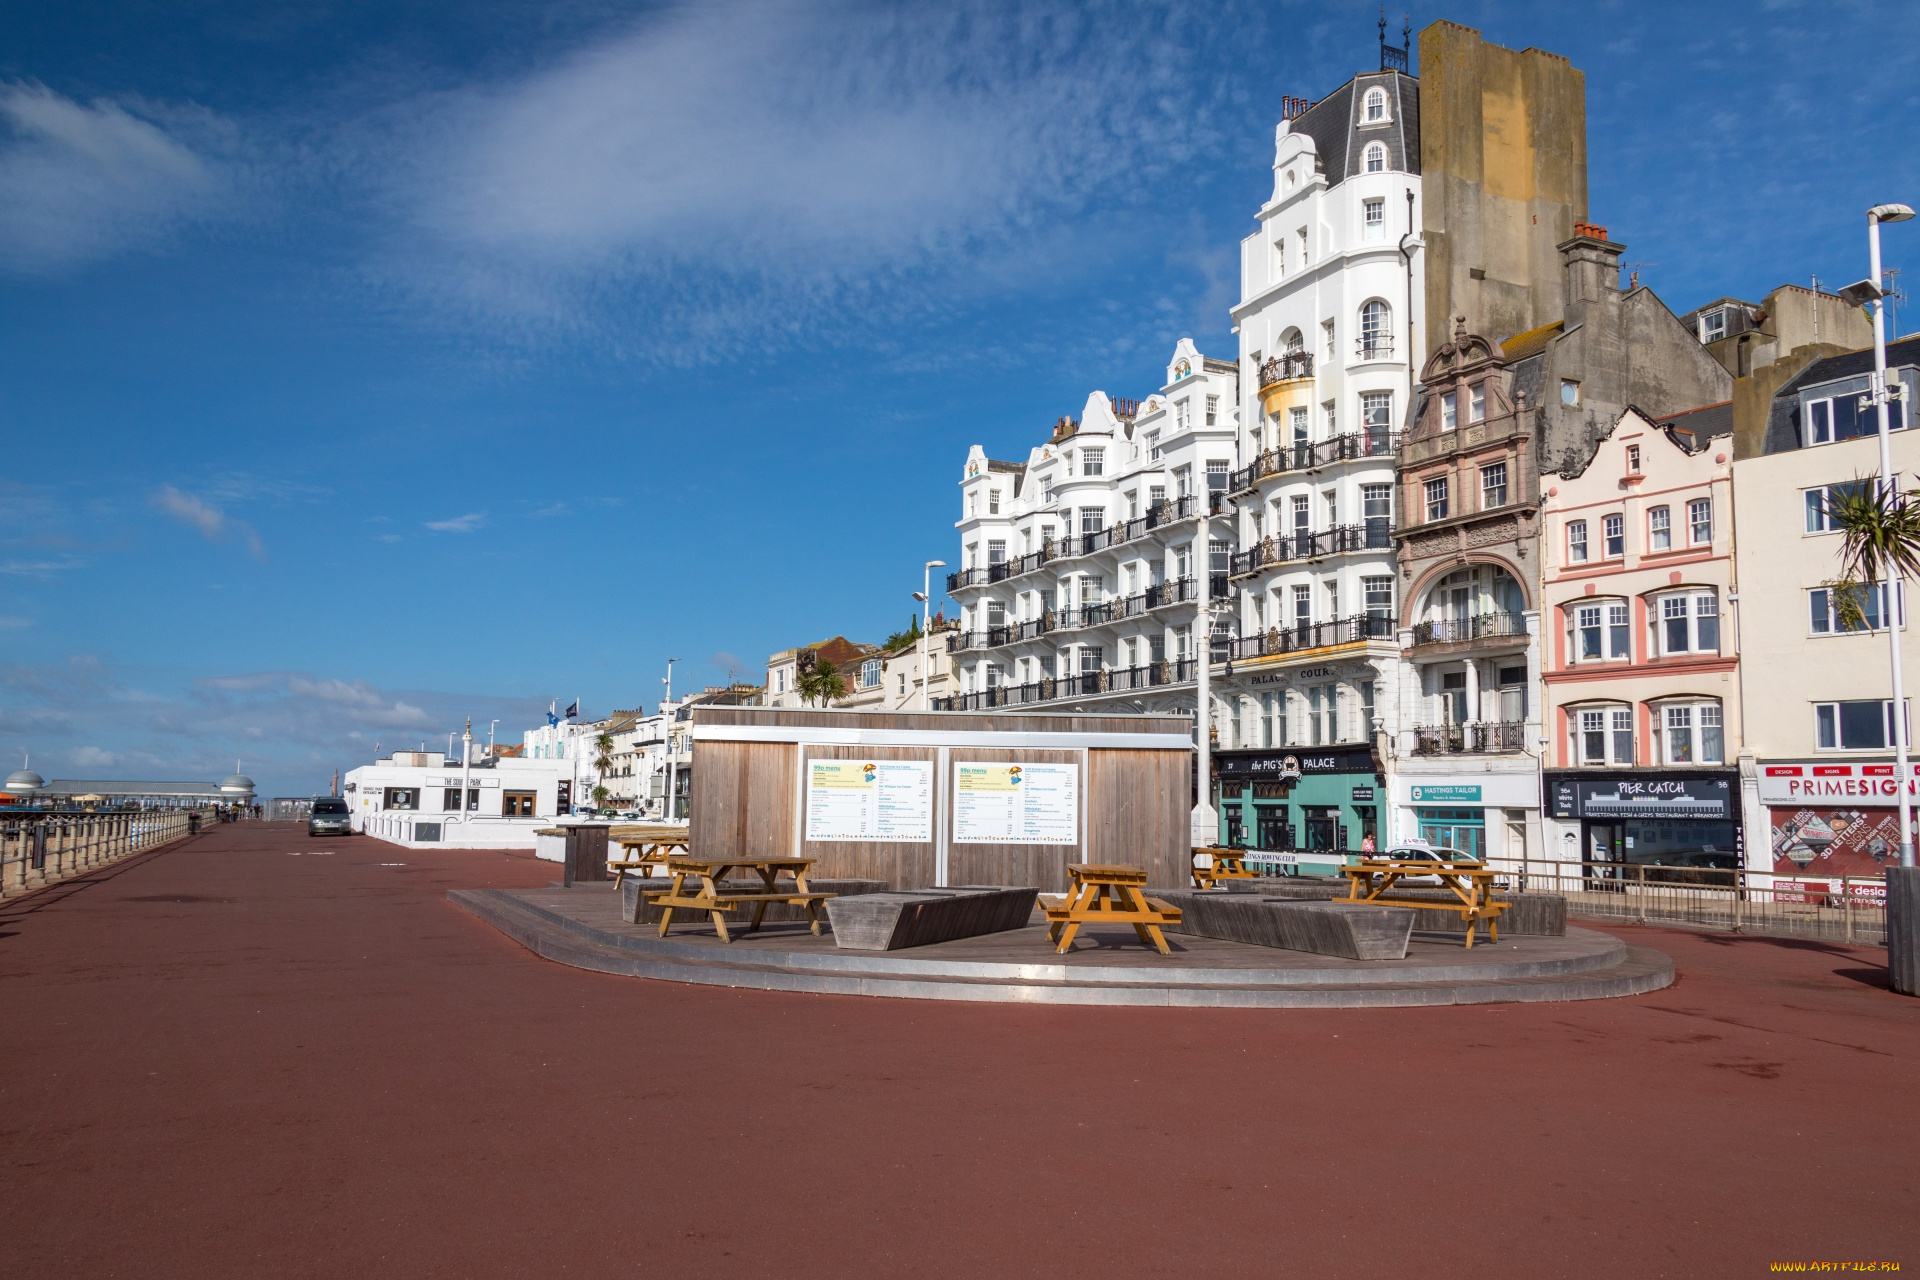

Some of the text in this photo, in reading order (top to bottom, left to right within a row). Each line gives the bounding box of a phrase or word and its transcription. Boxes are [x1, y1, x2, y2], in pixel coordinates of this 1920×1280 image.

[1252, 668, 1334, 685] PALAC COUR
[1251, 761, 1262, 770] the
[1264, 760, 1283, 770] PIG'S
[1304, 758, 1335, 769] PALACE
[470, 778, 482, 786] PARK
[1618, 782, 1685, 794] PIER CATCH
[1790, 779, 1920, 796] PRIMESIGN
[1798, 810, 1816, 828] SIGNS
[1821, 848, 1833, 860] 3D
[1832, 818, 1865, 850] LETTERS
[1846, 824, 1872, 848] SIGNS
[1853, 816, 1893, 853] SHOP SIGN WORK
[1883, 826, 1902, 844] FLYER
[1244, 852, 1296, 863] STINGS ROWING CLUB
[1856, 886, 1887, 897] desig
